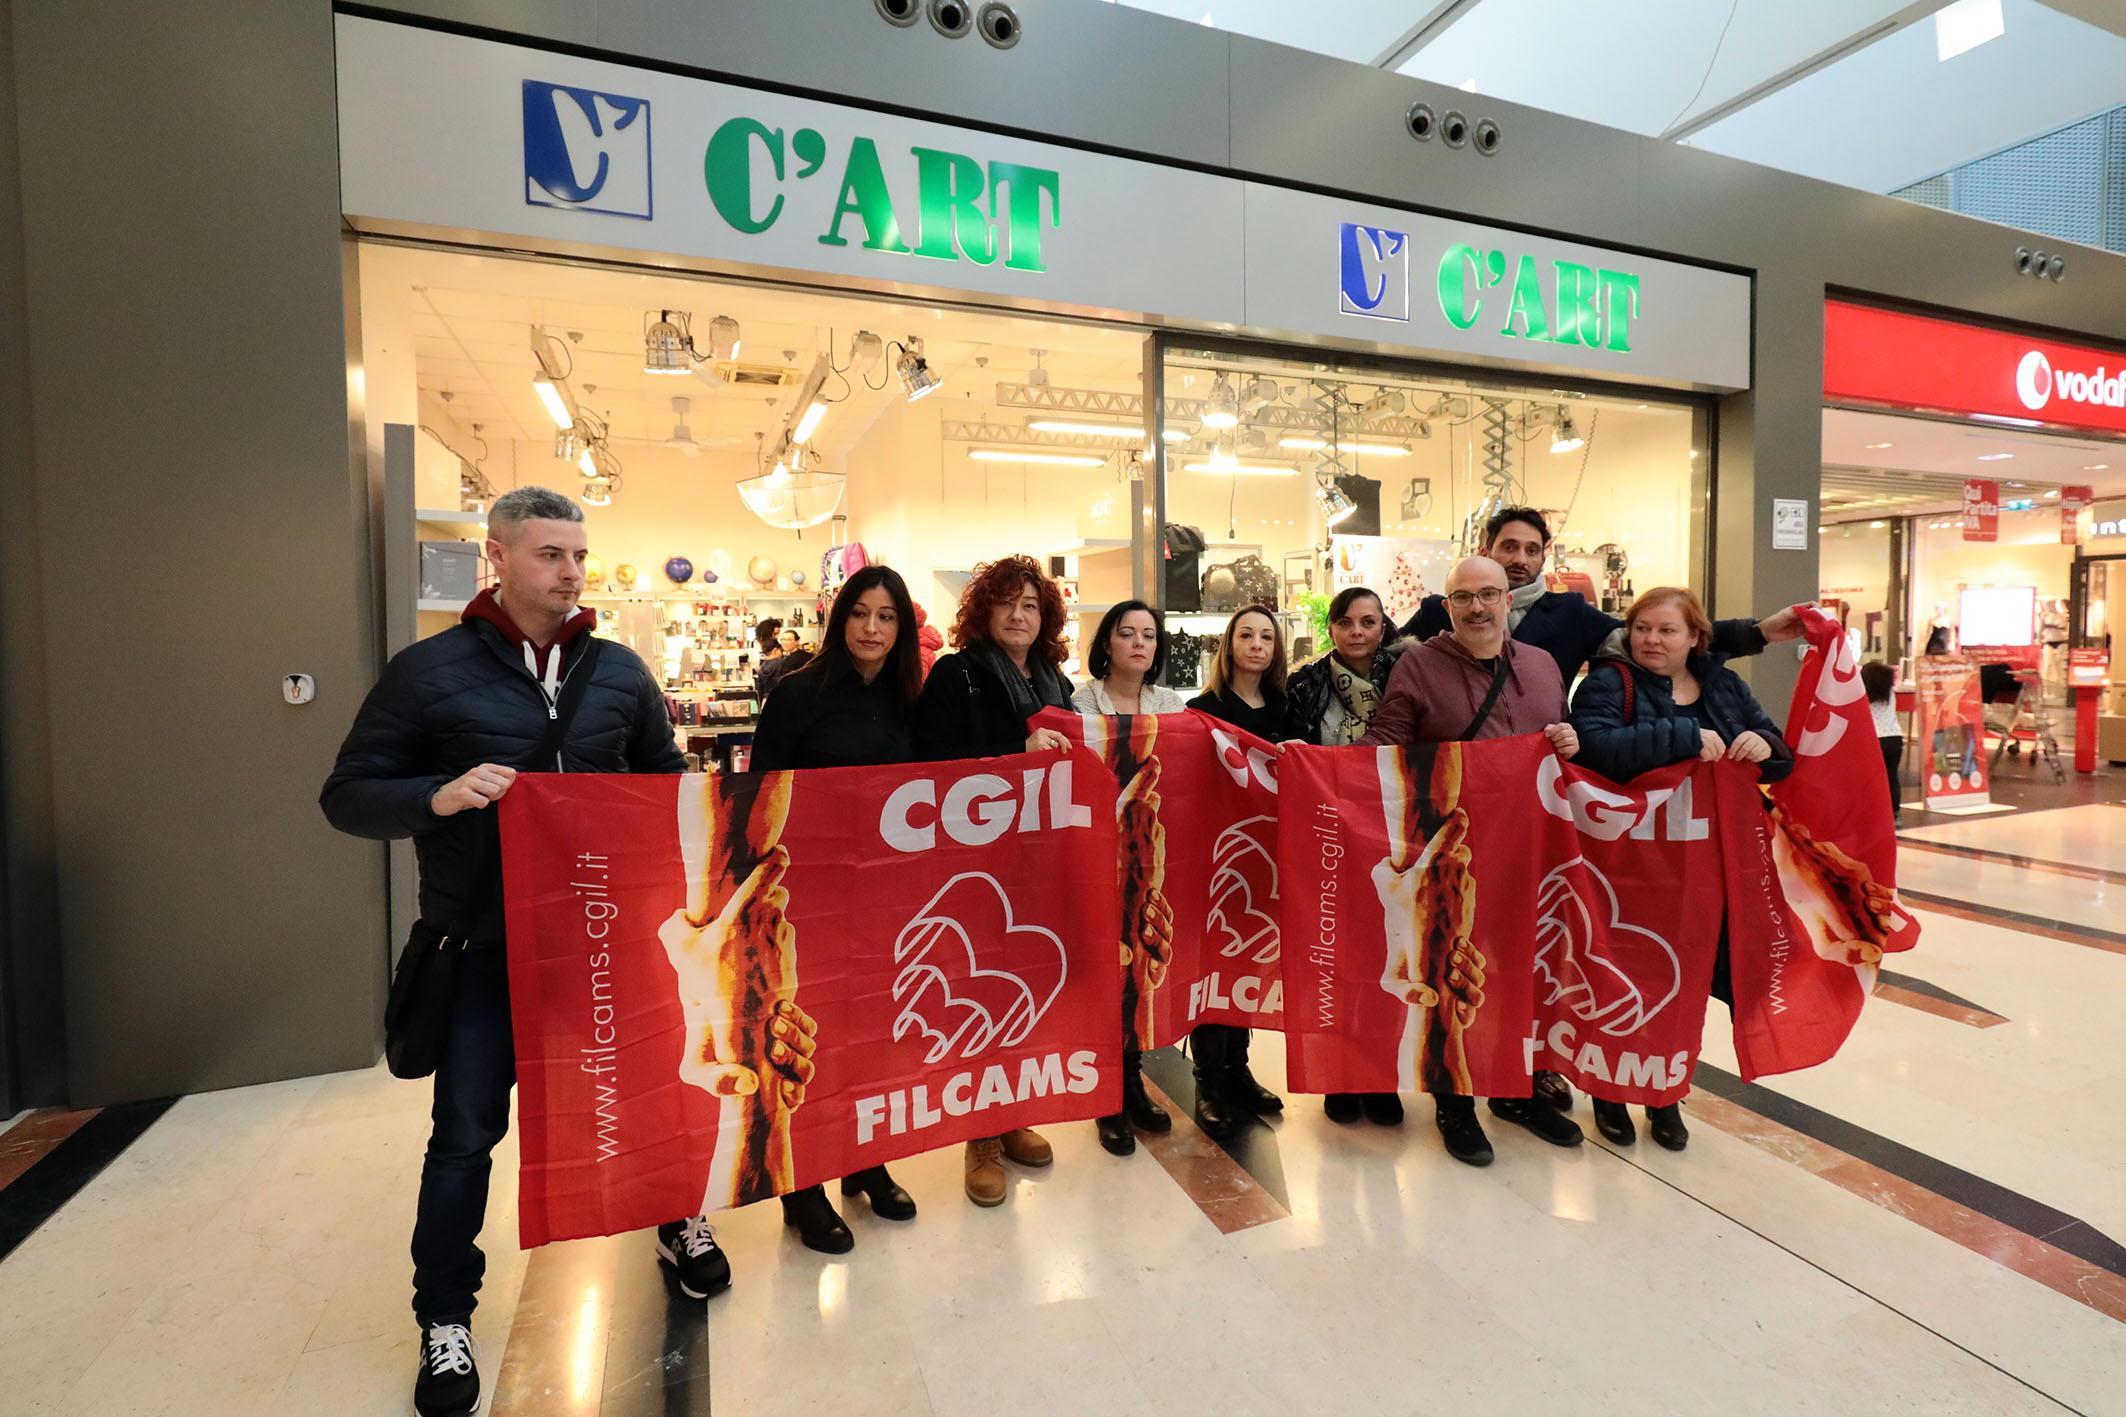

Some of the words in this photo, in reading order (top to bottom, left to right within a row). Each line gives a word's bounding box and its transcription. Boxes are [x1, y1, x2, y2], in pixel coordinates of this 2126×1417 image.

[704, 116, 1060, 273] C'ART
[1437, 242, 1640, 353] C'ART
[879, 760, 1092, 853] CGIL
[1309, 802, 1345, 1028] www.filcams.cgil.it
[570, 850, 620, 1163] www.filcams.cgil.it
[855, 1050, 1099, 1146] FILCAMS
